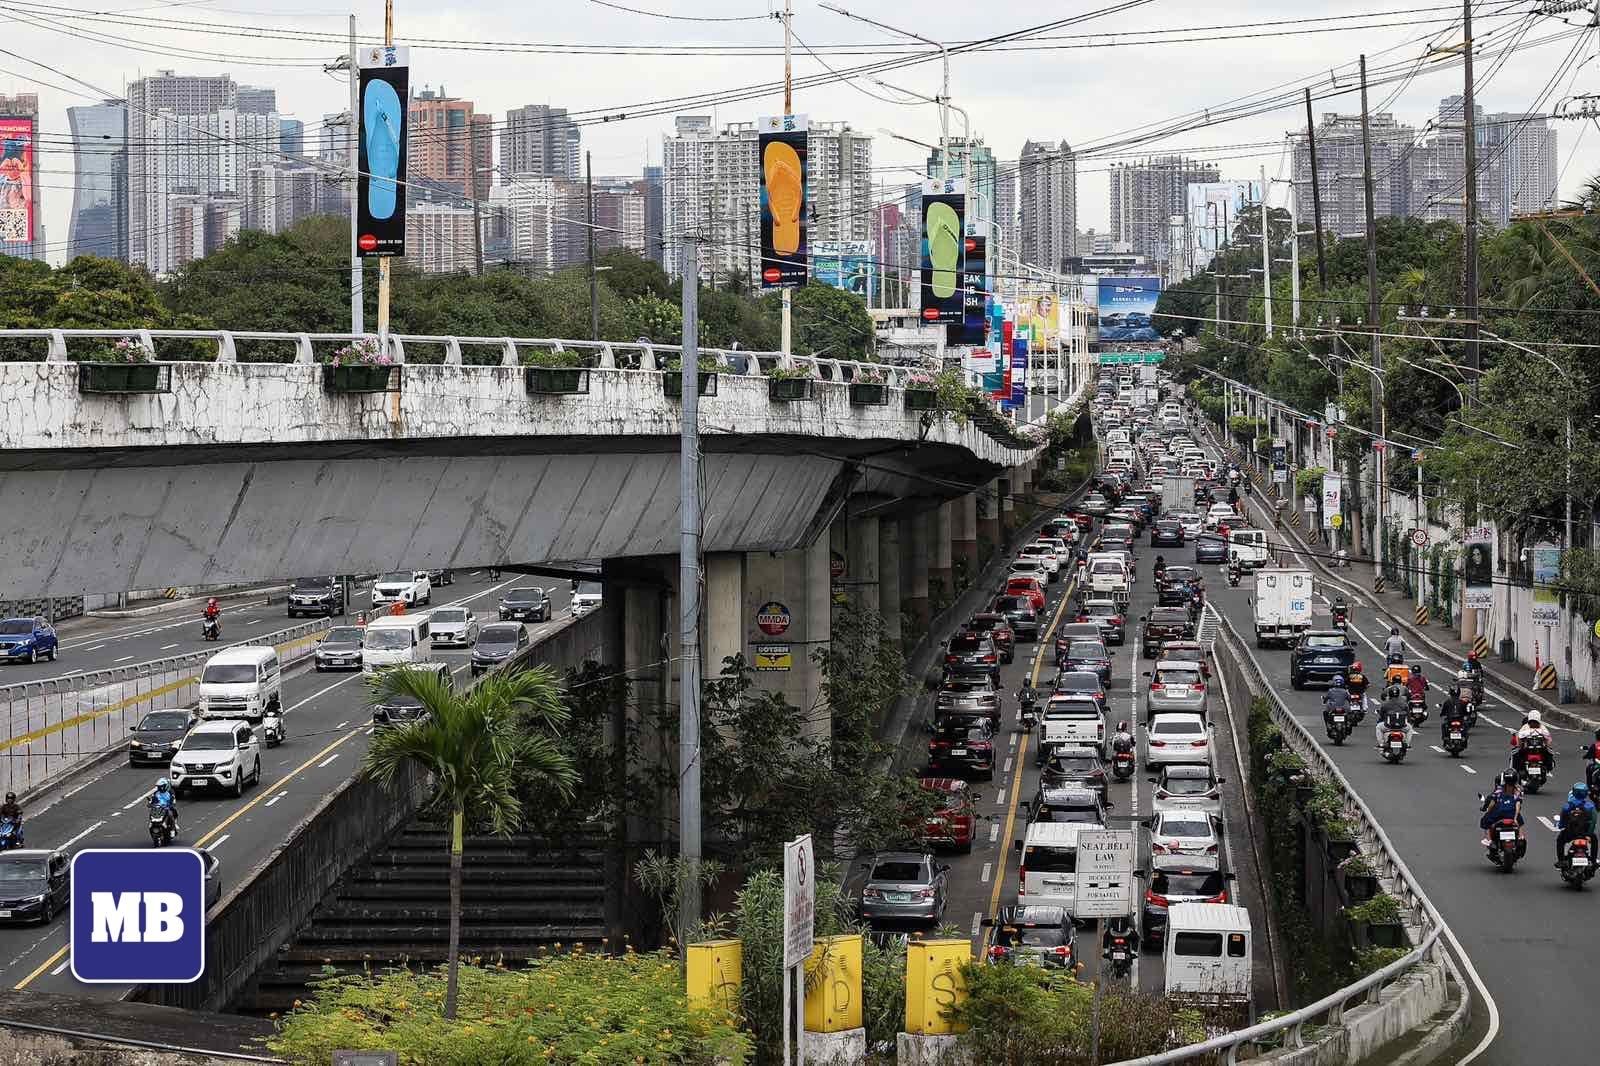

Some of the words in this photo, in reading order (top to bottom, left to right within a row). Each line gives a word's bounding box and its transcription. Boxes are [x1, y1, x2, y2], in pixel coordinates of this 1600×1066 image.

[1291, 600, 1305, 611] ICE
[759, 615, 788, 624] MMDA
[1095, 853, 1114, 862] LAW
